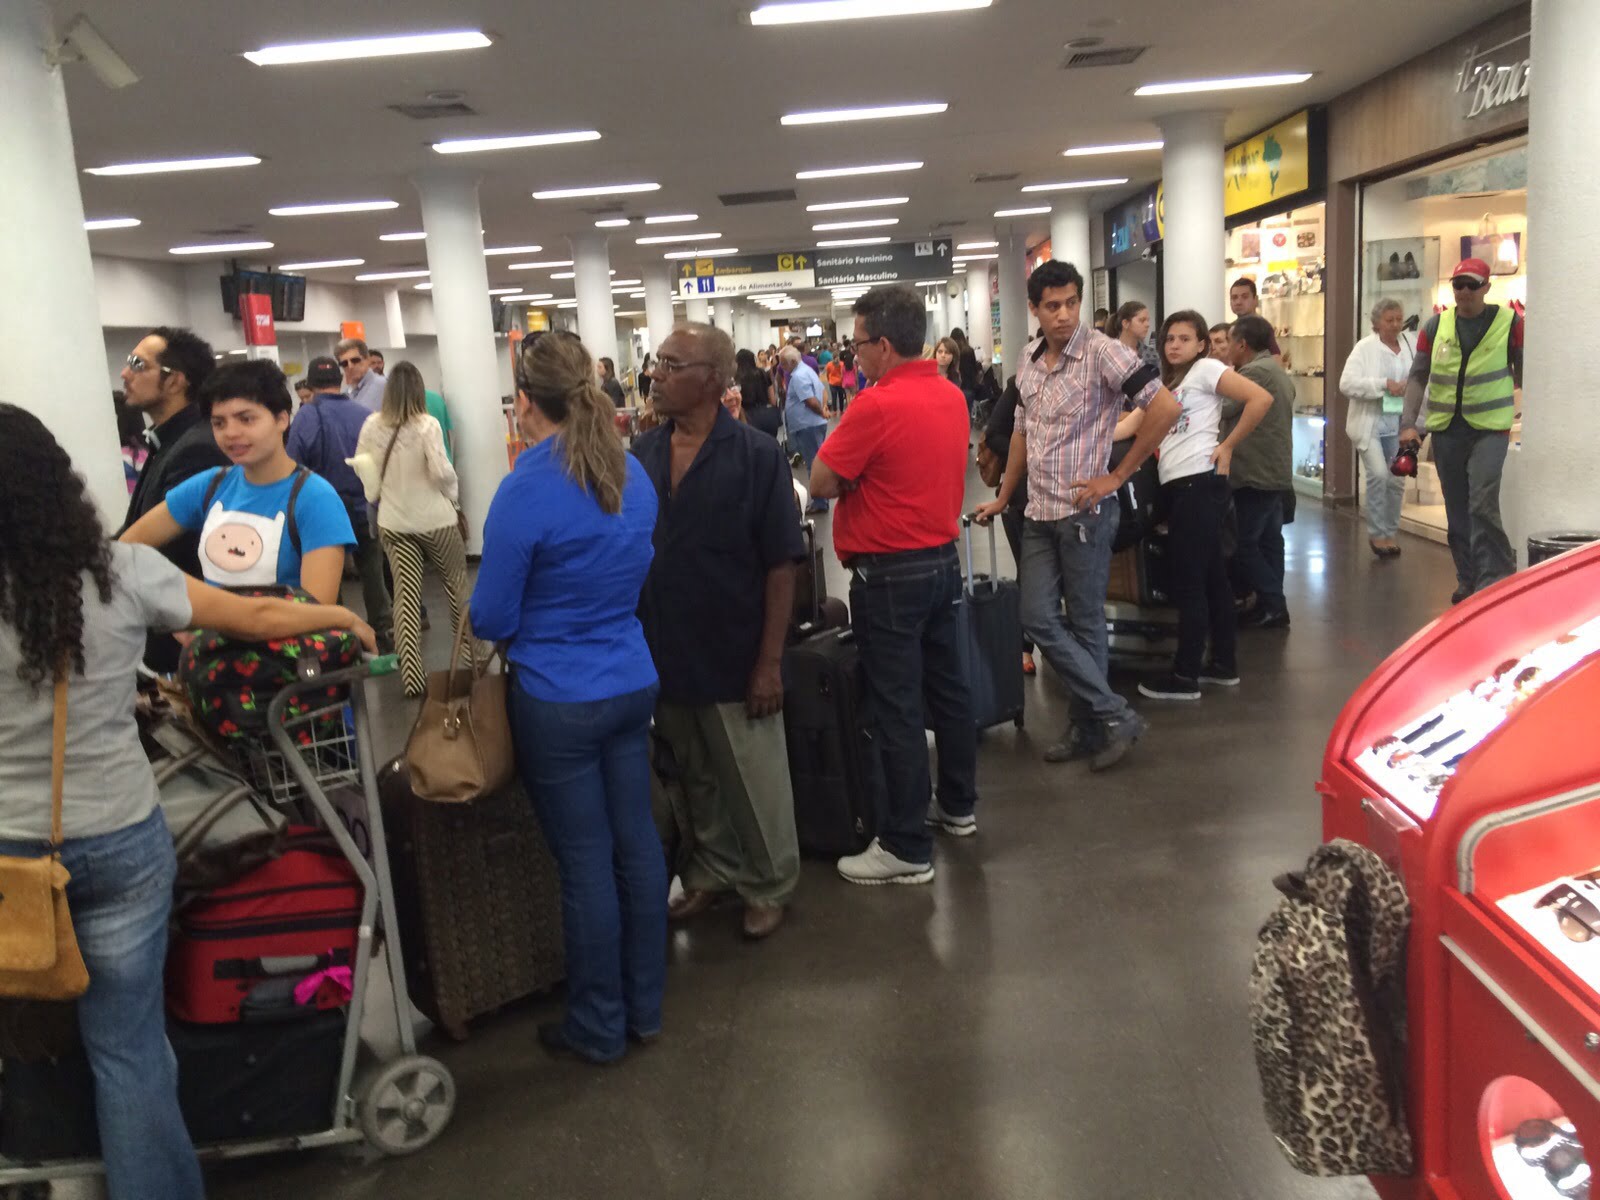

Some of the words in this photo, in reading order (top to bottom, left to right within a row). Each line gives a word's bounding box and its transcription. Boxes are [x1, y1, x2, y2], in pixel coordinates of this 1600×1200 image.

[780, 256, 792, 269] C
[816, 256, 854, 267] Sanitário
[855, 254, 893, 264] Feminino
[818, 274, 855, 285] Sanitário
[856, 271, 898, 282] Masculino
[717, 285, 736, 294] Praça
[749, 281, 793, 290] Alimentação
